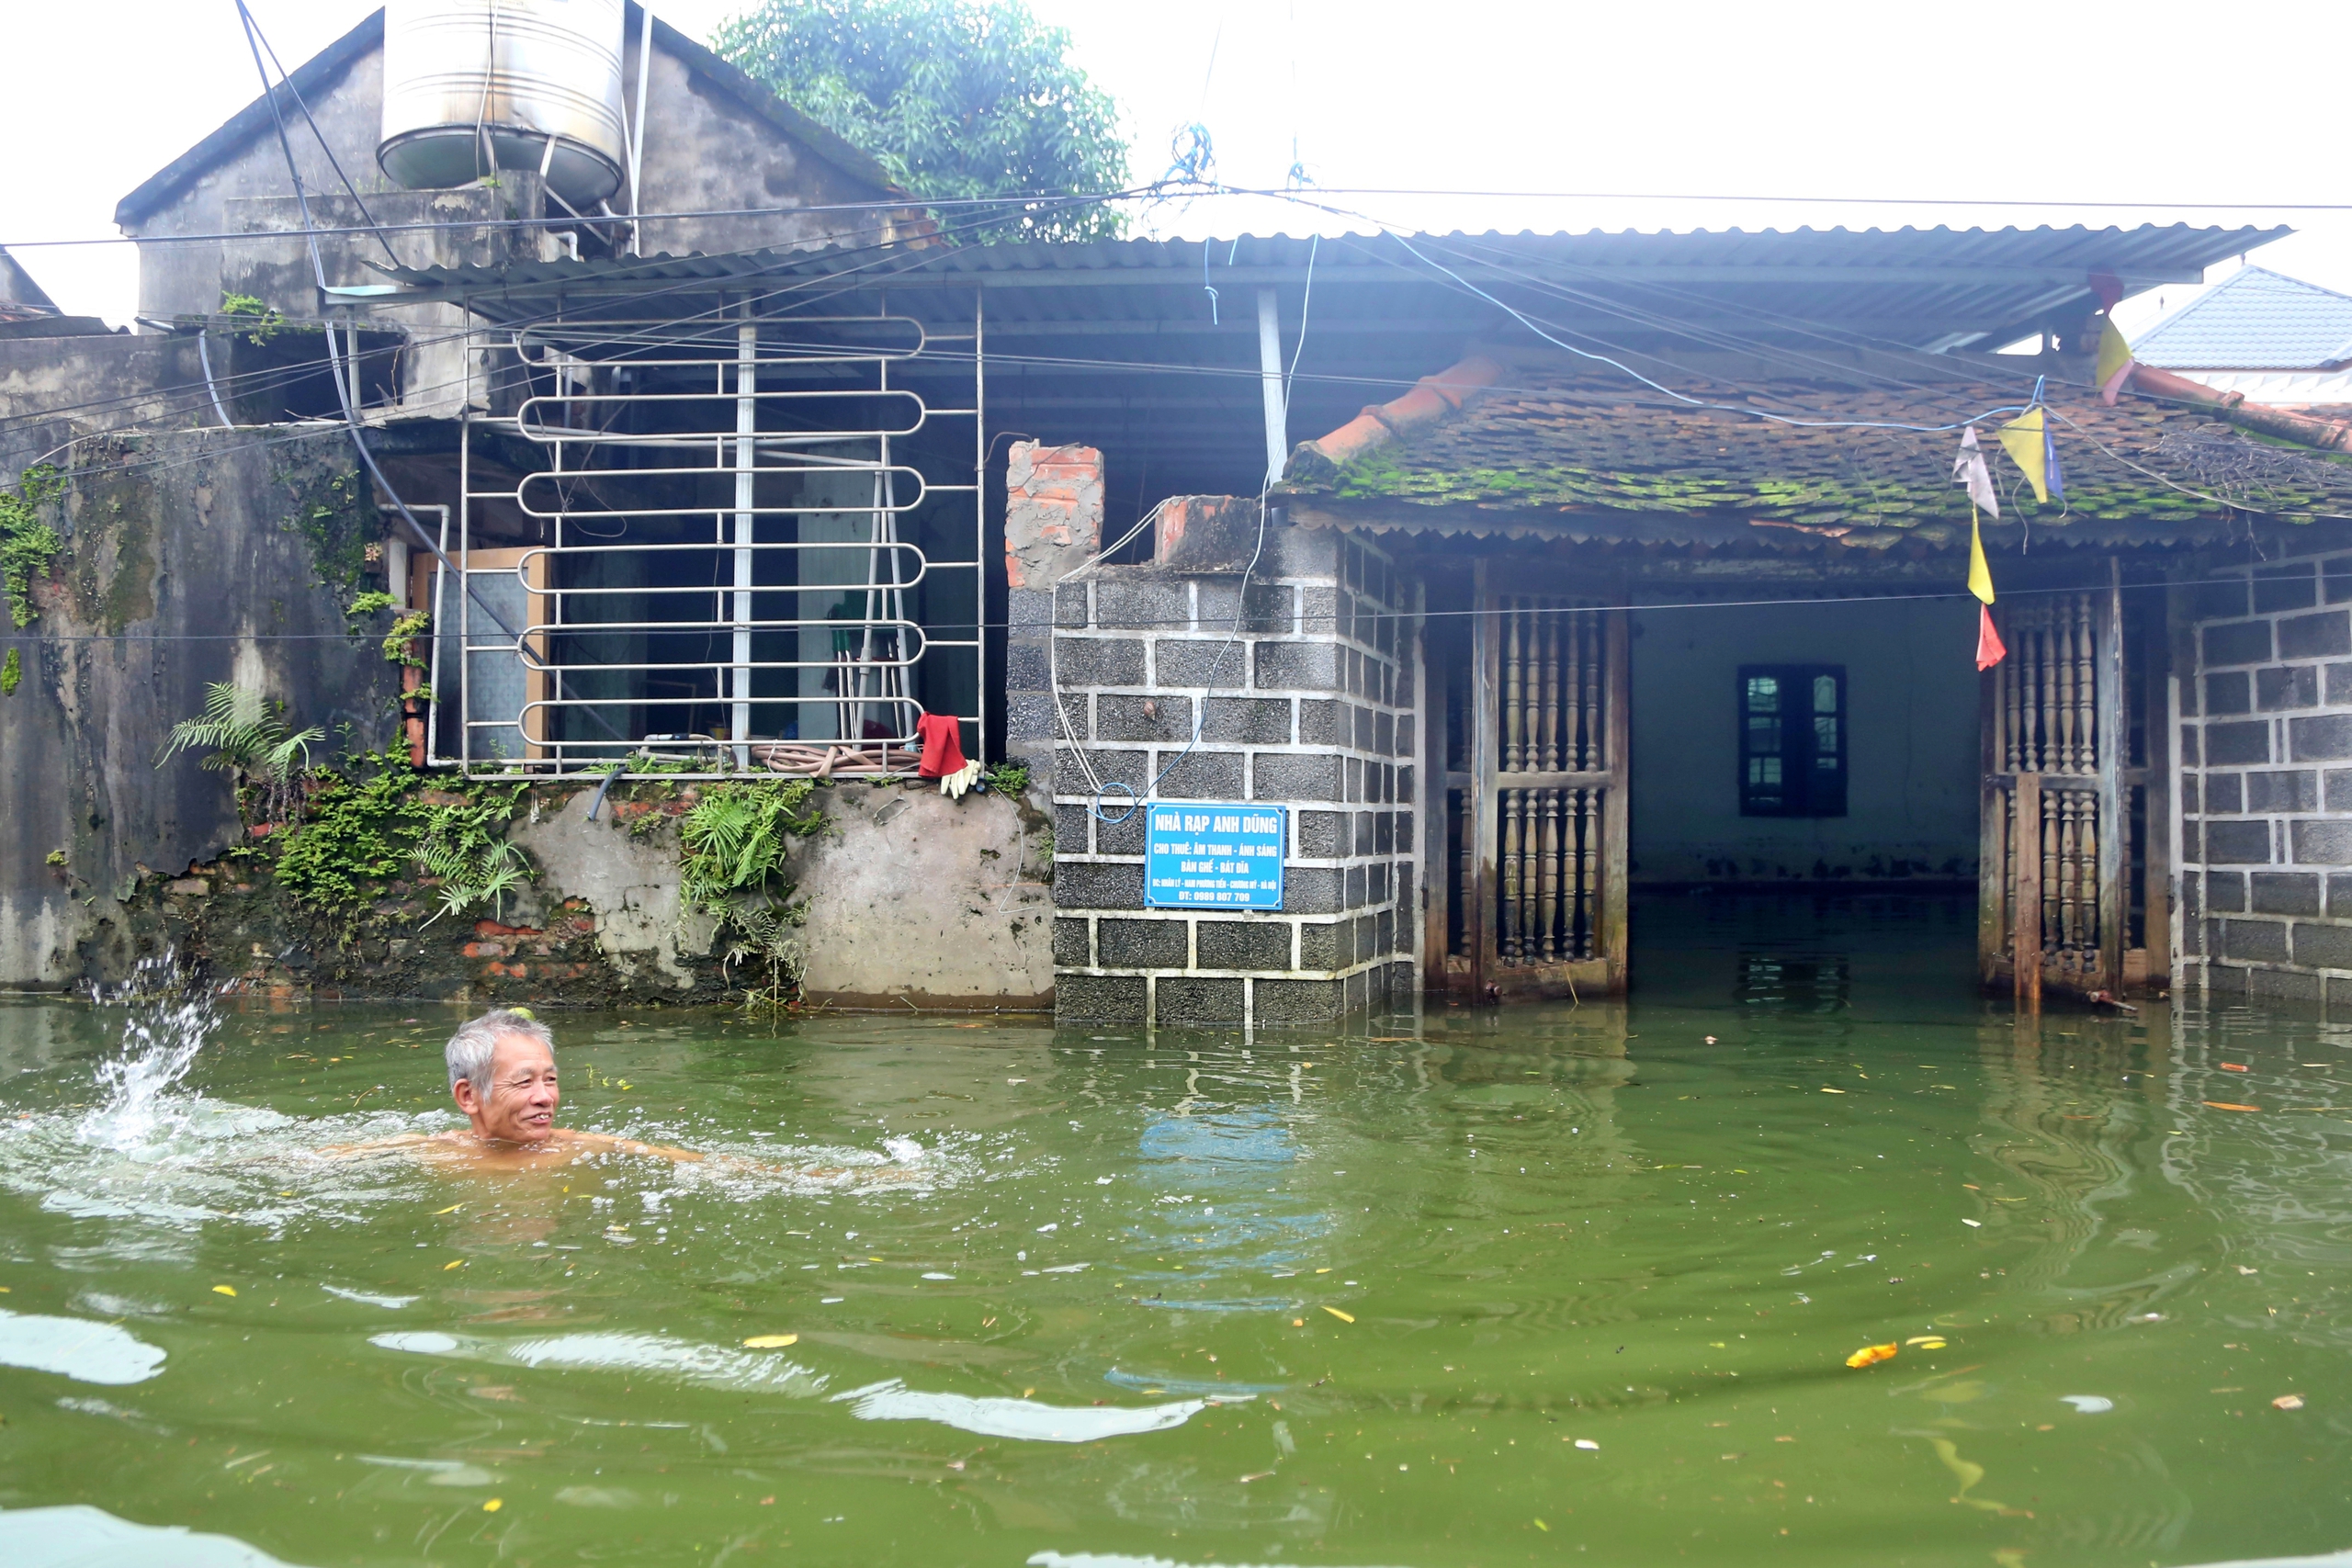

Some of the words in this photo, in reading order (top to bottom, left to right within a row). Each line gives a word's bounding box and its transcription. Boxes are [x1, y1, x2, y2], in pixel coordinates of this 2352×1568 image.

[1155, 811, 1182, 831] NHÀ
[1184, 815, 1210, 836] RẠP
[1213, 816, 1239, 833] ANH
[1242, 813, 1278, 834] DŨNG
[1153, 843, 1170, 854] CHO
[1170, 841, 1193, 855] THUÊ:
[1193, 841, 1206, 855] ÂM
[1207, 844, 1232, 856] THANH
[1238, 842, 1255, 857] ÁNH
[1256, 843, 1277, 857] SÁNG
[1181, 859, 1197, 873] BÀN
[1198, 858, 1215, 873] GHẾ
[1220, 860, 1236, 874] BÁT
[1178, 890, 1192, 901] ĐT:
[1193, 891, 1216, 902] 0989
[1216, 891, 1233, 902] 807
[1234, 892, 1250, 903] 709
